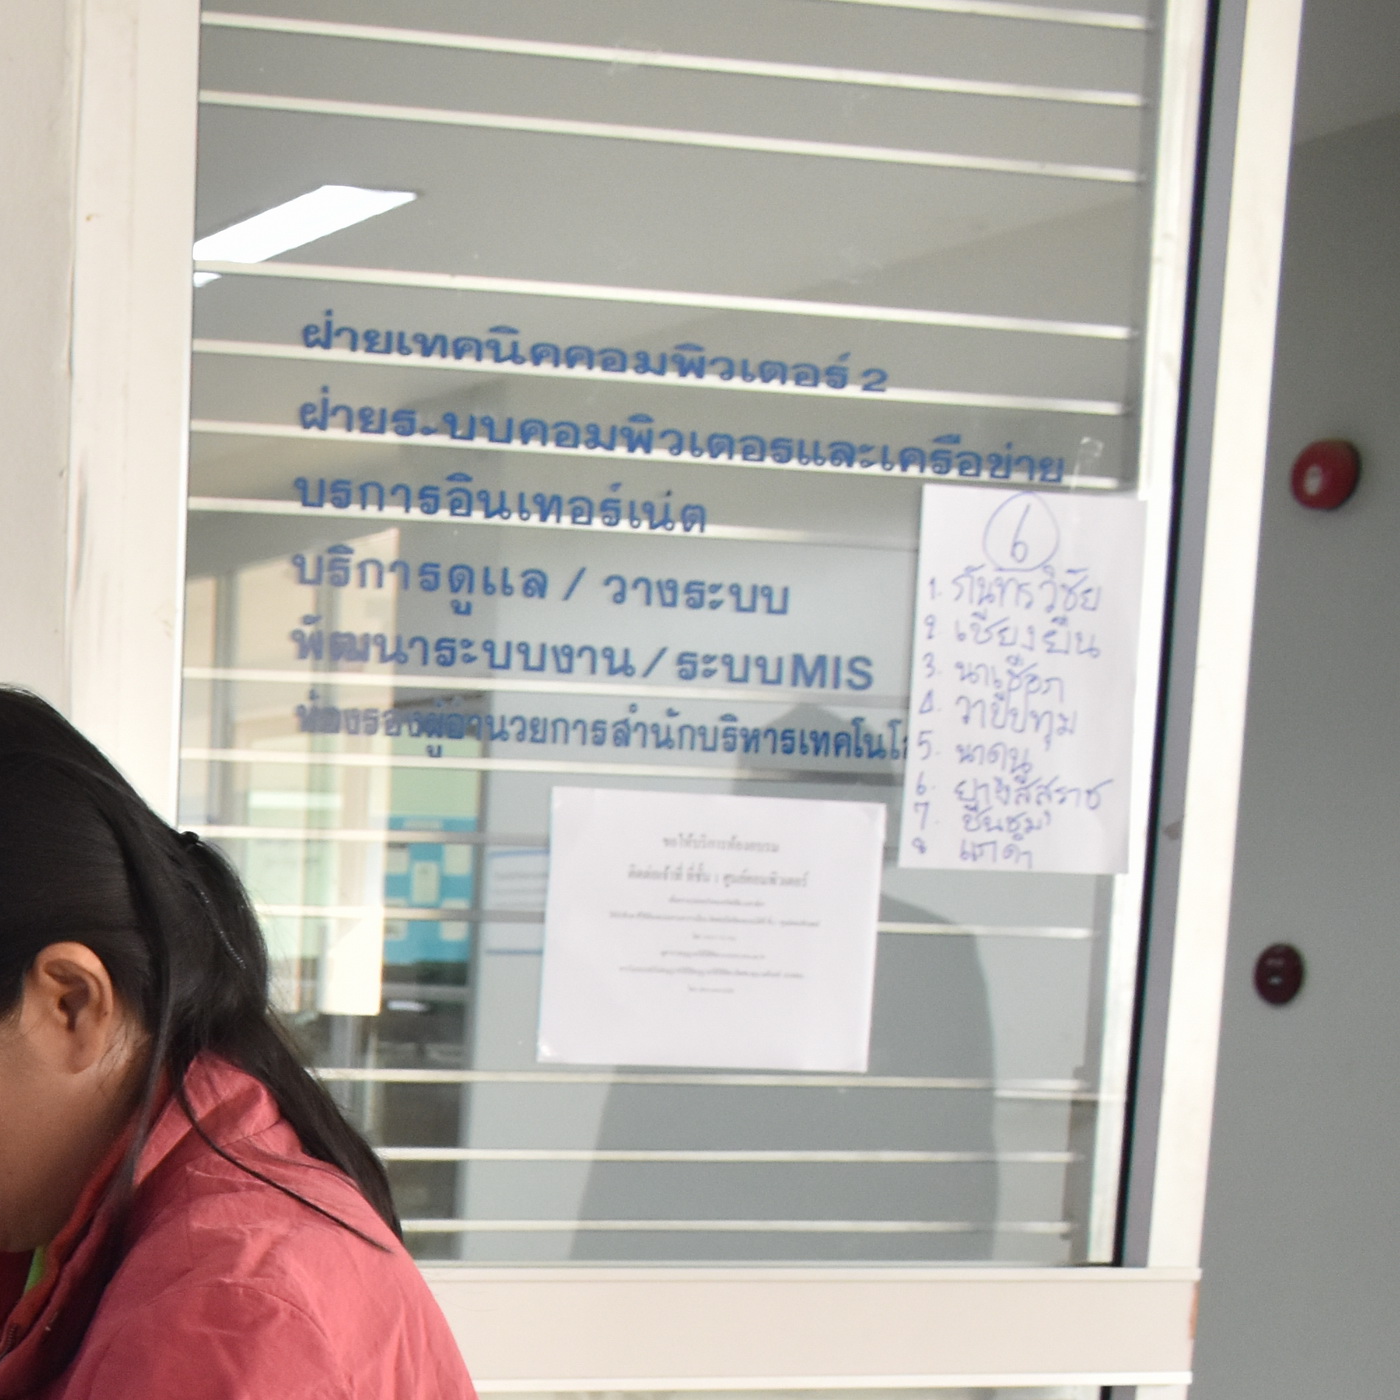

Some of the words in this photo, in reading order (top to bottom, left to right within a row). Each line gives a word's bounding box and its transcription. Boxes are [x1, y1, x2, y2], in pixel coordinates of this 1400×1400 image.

[303, 309, 850, 389] ฝ่ายเทคนิคคอมพิวเตอร์
[861, 368, 889, 392] 2
[1010, 503, 1032, 563] 6
[291, 544, 549, 616] บริการดูแล
[603, 574, 790, 616] วางระบบ
[295, 689, 909, 760] ห้องรองผู้อำนวยการสำนักบริหารเทคโนโ
